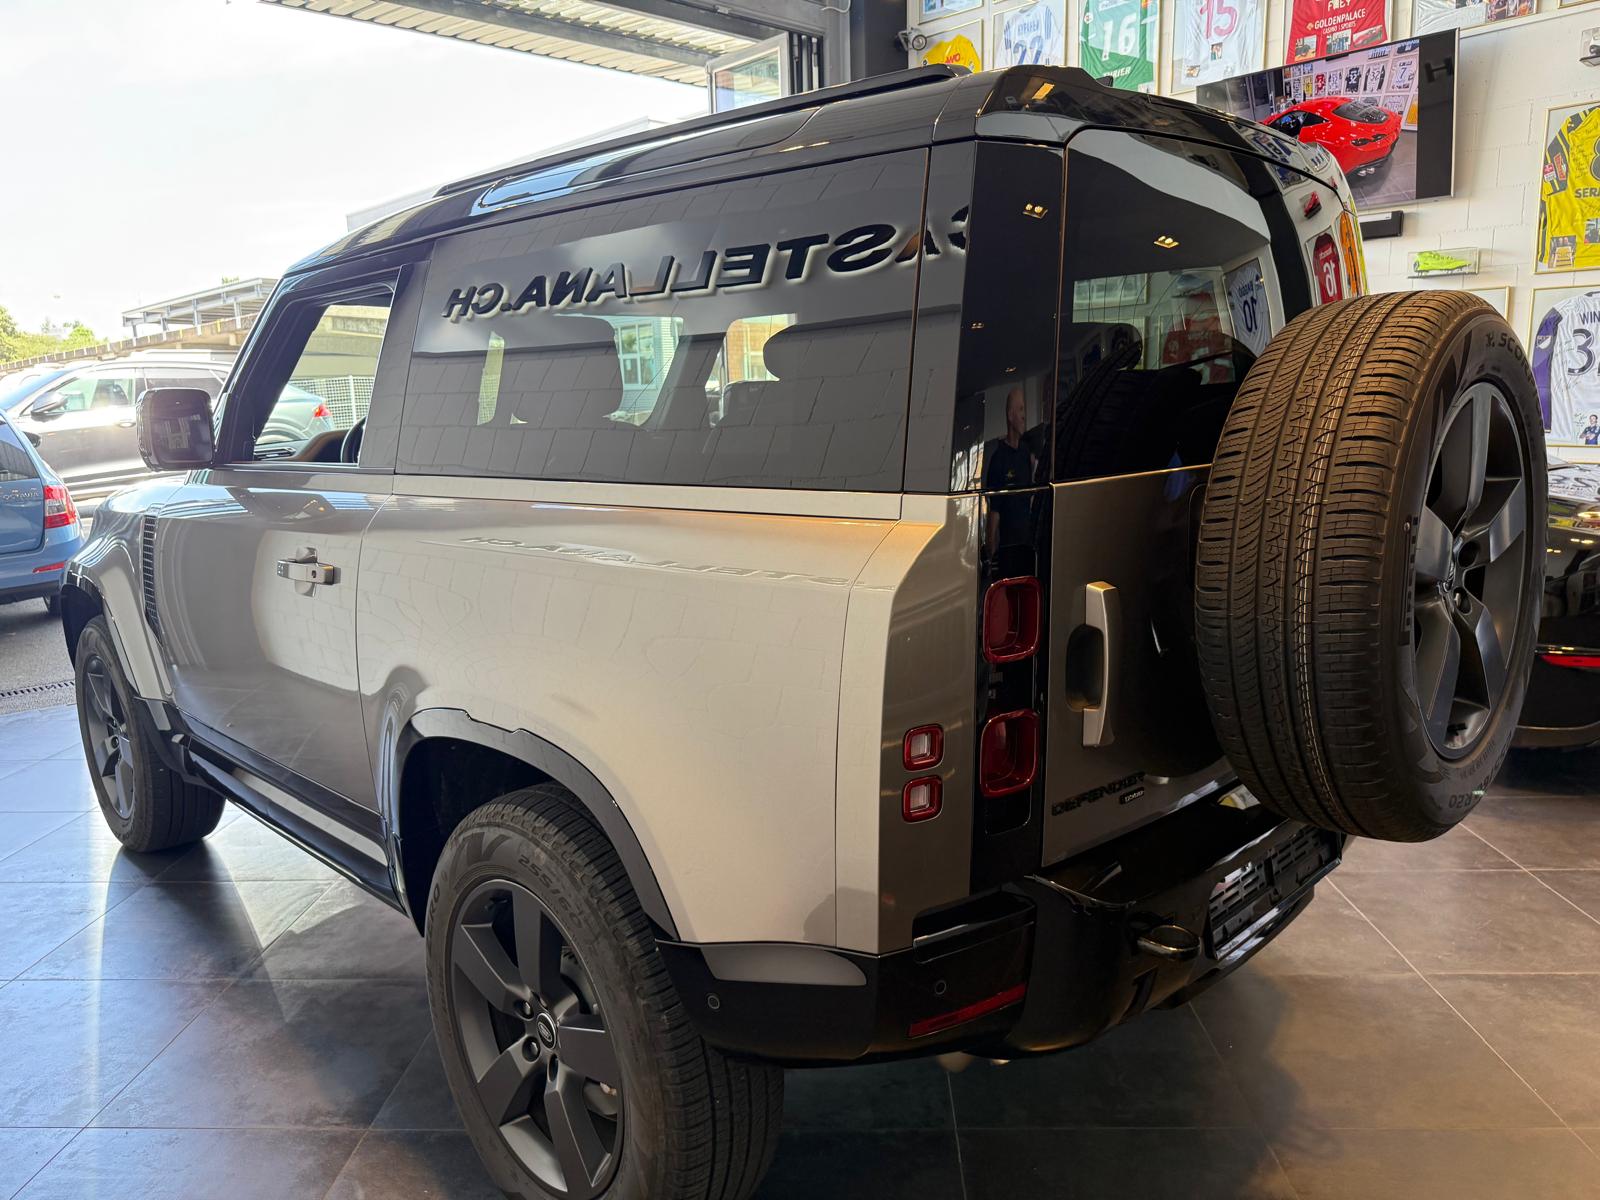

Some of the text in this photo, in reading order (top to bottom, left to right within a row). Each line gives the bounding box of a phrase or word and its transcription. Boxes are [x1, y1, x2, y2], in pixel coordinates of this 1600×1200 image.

[1314, 8, 1366, 29] GOLDENPALACE
[1327, 0, 1351, 11] FEY
[1102, 13, 1137, 61] 16
[1568, 329, 1600, 377] 3
